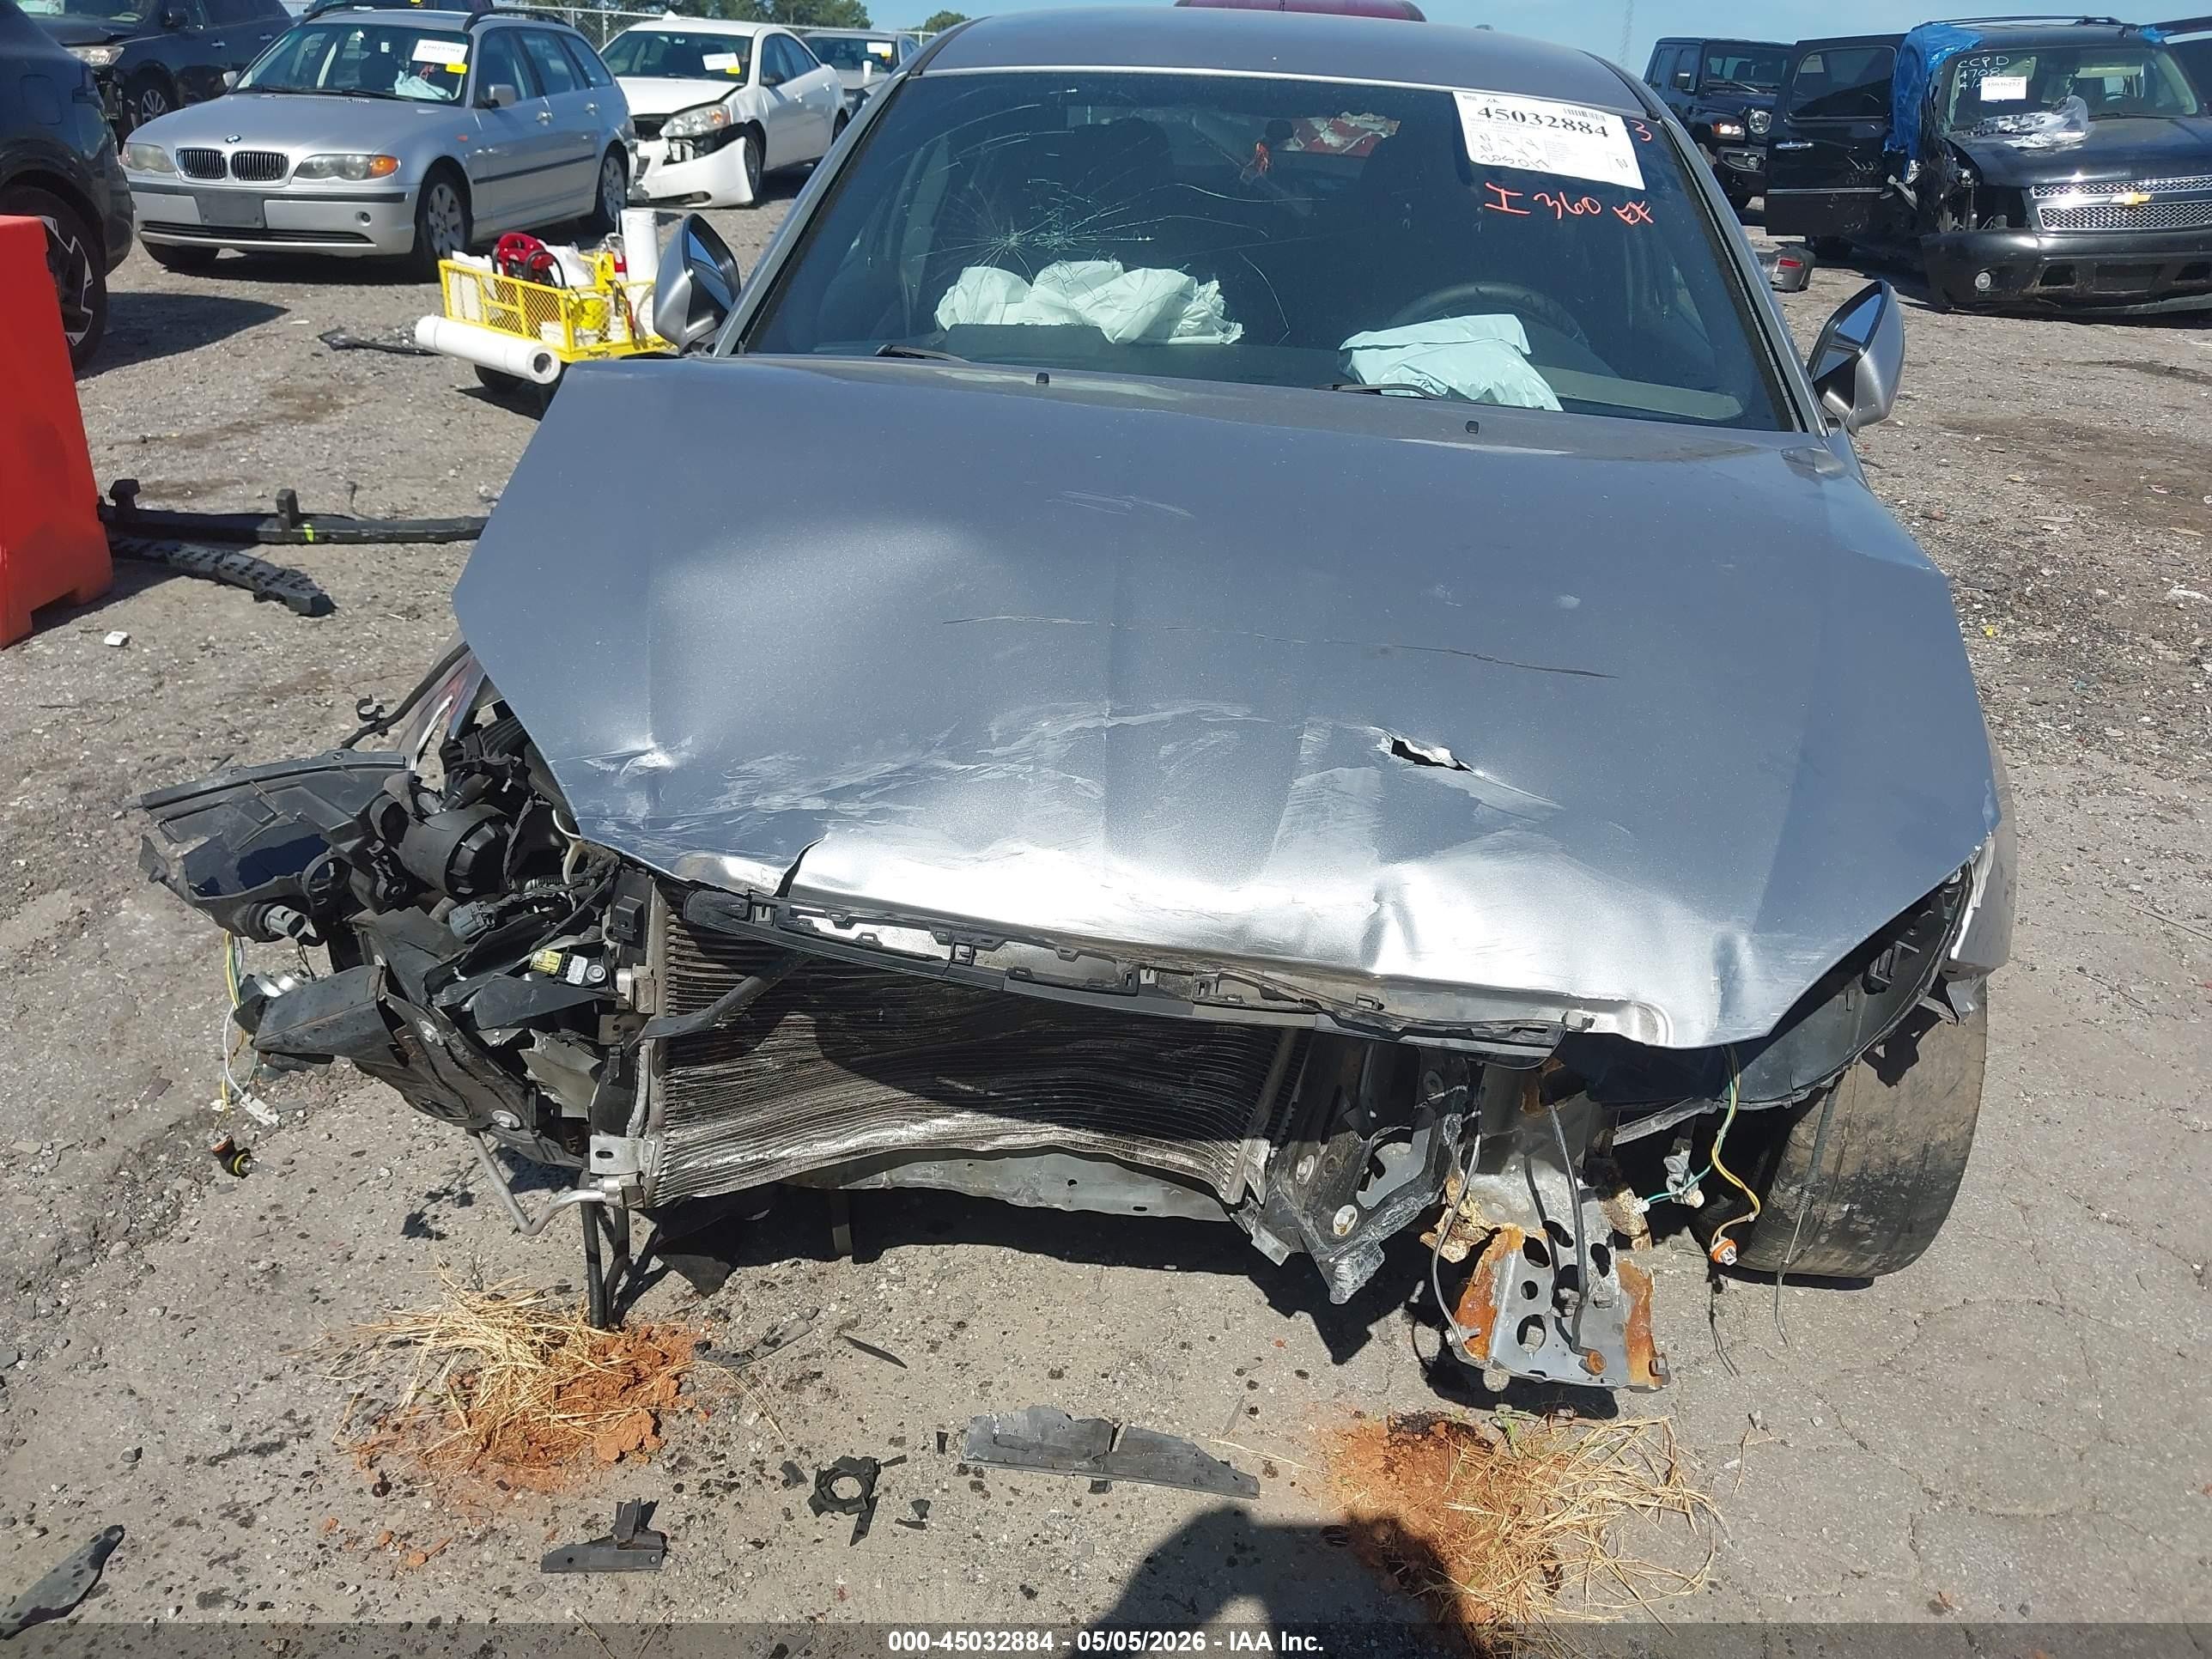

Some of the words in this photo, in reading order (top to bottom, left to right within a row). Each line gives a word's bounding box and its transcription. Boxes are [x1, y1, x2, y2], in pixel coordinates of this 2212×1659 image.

[1477, 107, 1608, 137] 45032884
[1629, 119, 1653, 142] 3
[1533, 191, 1602, 220] 360
